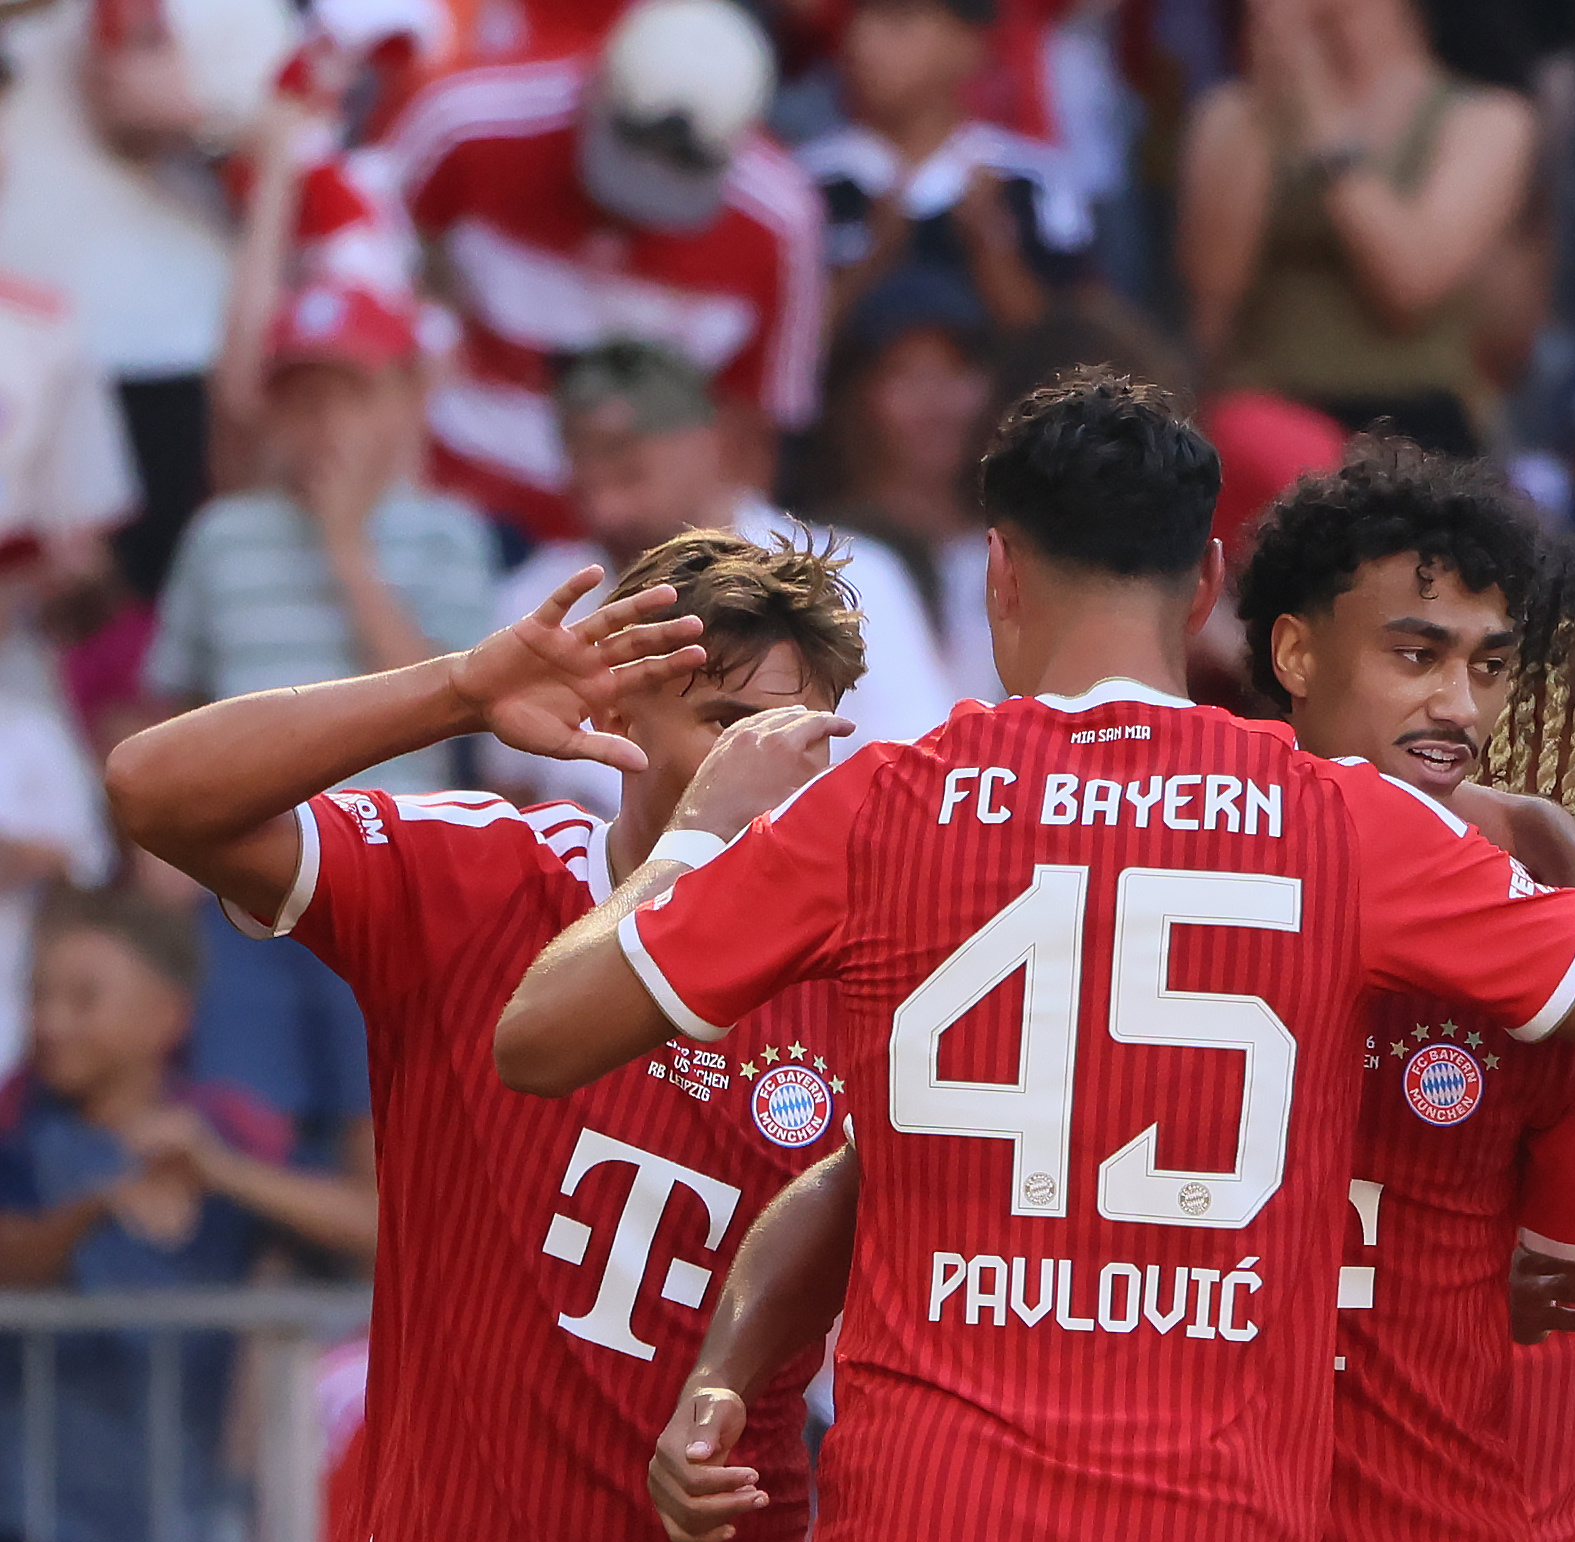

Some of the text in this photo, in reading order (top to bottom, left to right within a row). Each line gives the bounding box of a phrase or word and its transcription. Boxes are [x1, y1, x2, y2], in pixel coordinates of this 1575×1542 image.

[1070, 724, 1151, 744] MIA SAN MIA
[938, 766, 1283, 838] FC BAYERN
[692, 1049, 727, 1070] 2026
[889, 863, 1303, 1229] 45
[647, 1060, 711, 1102] RB LEIPZIG
[1411, 1049, 1477, 1083] FC BAYERN
[760, 1071, 825, 1104] FC BAYERN
[928, 1251, 1263, 1342] PAVLOVIĆ
